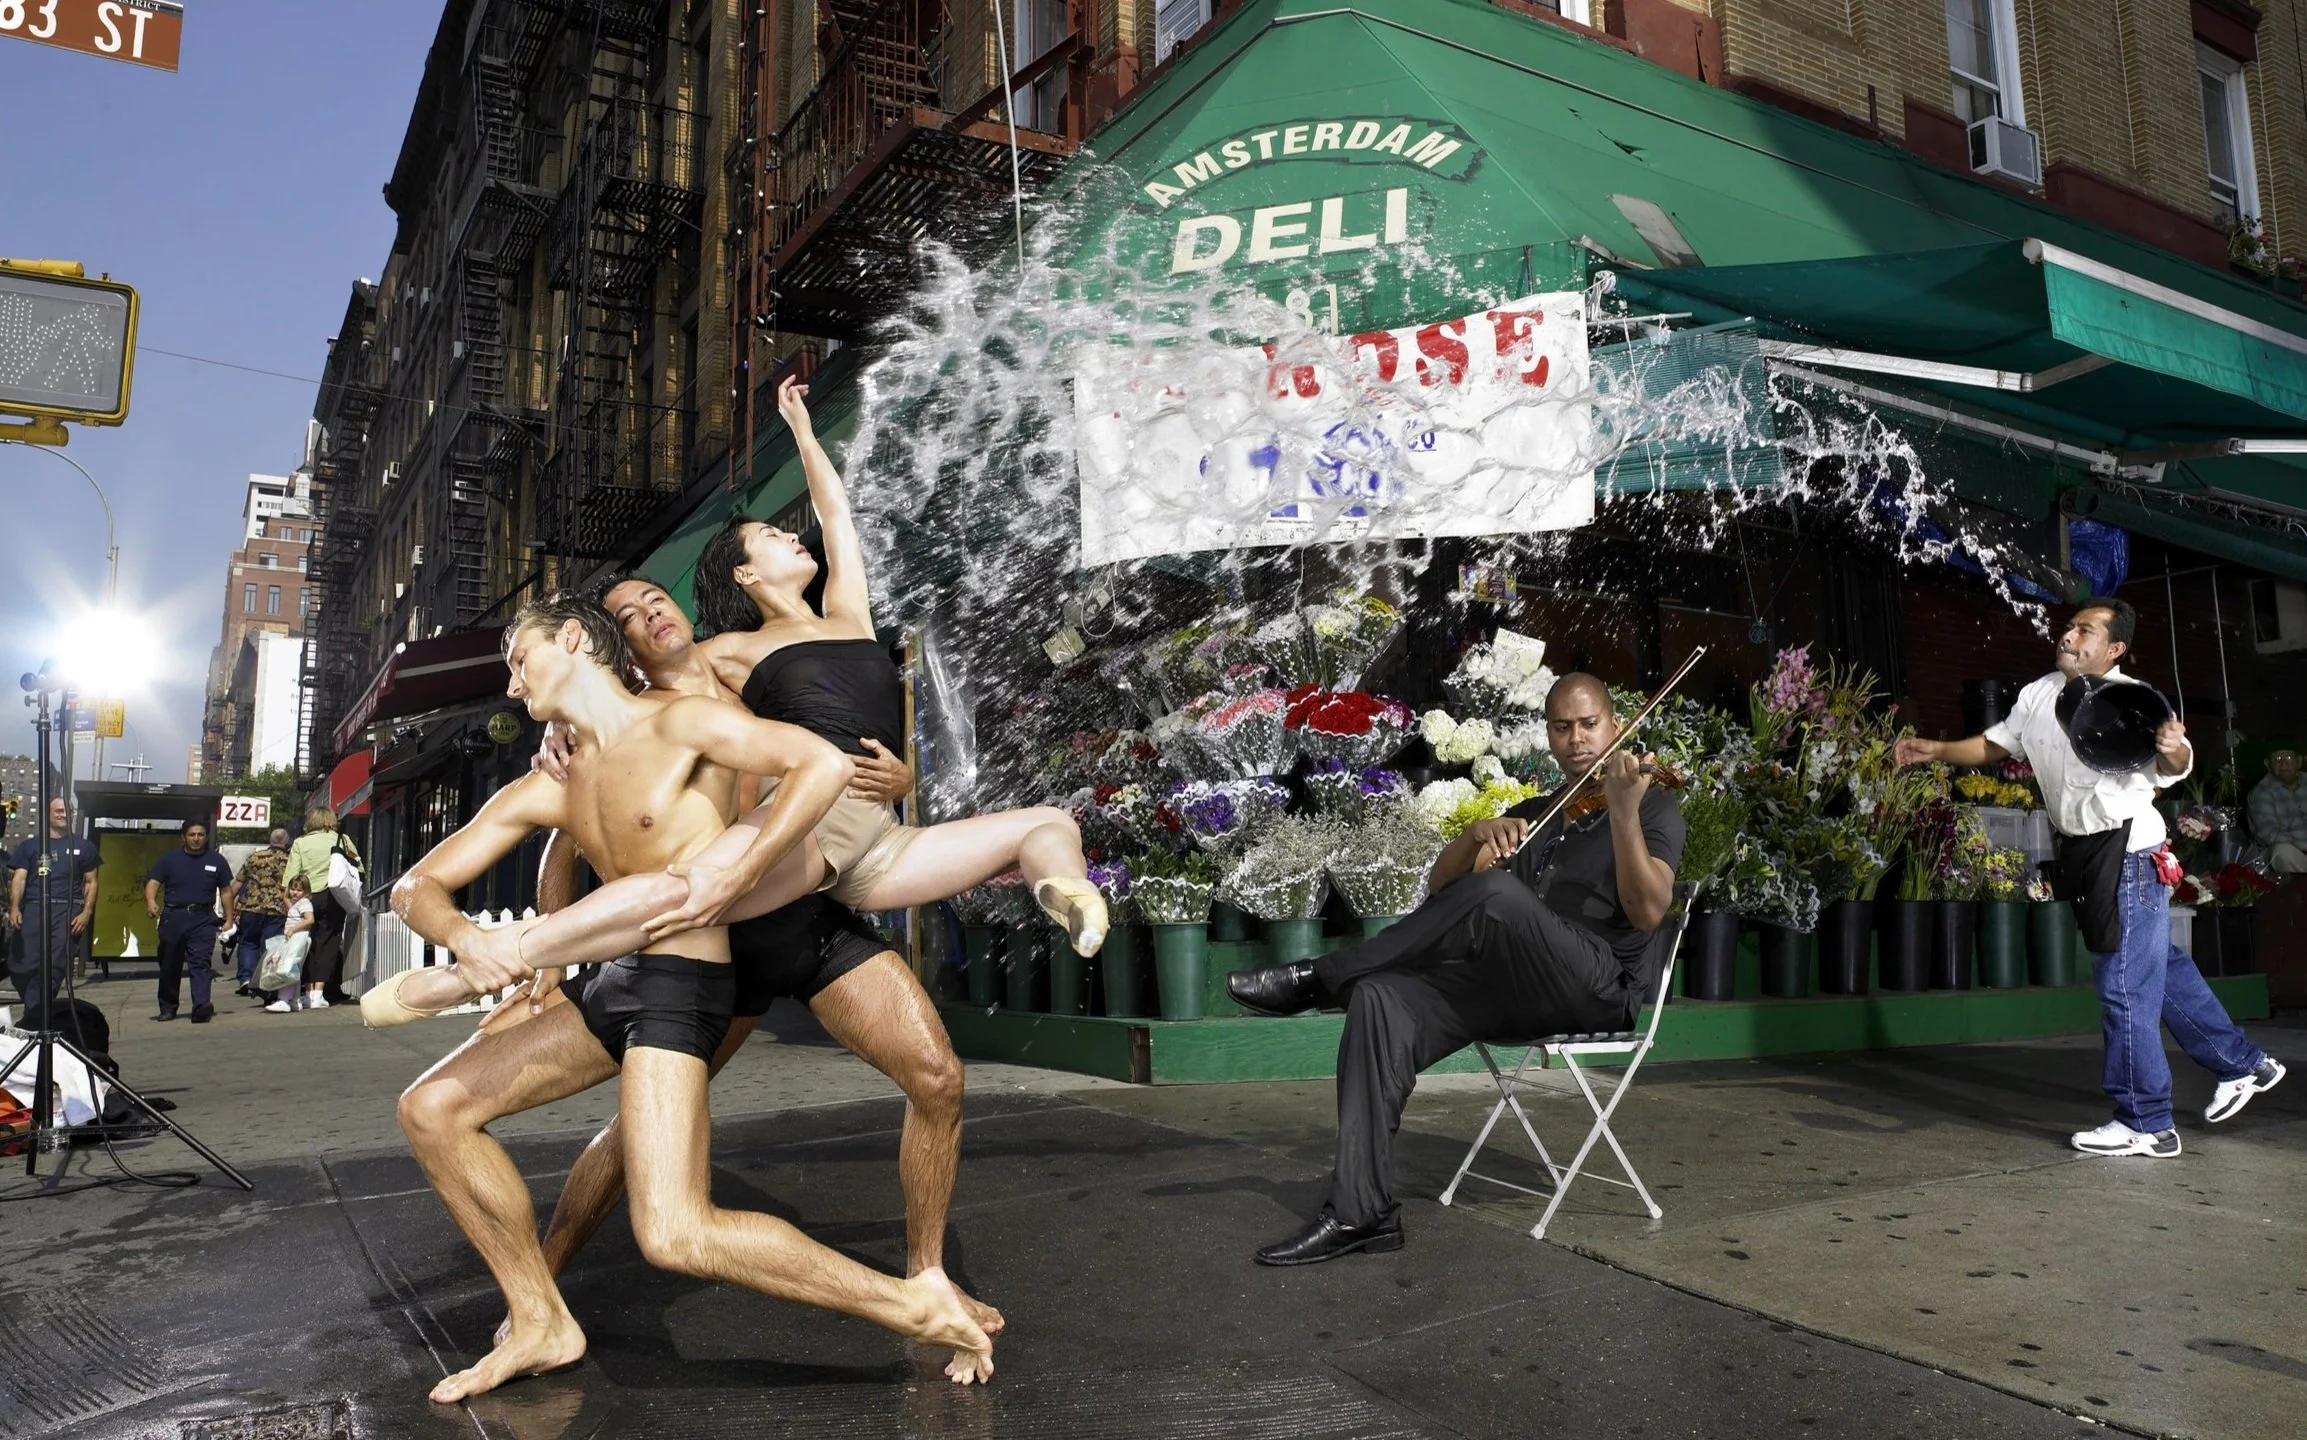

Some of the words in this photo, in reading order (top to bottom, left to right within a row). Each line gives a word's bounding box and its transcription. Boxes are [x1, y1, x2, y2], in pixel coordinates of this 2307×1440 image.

[94, 2, 153, 58] ST
[113, 0, 161, 11] TRICT
[1144, 121, 1462, 207] AMSTERDAM
[1171, 187, 1408, 275] DELI
